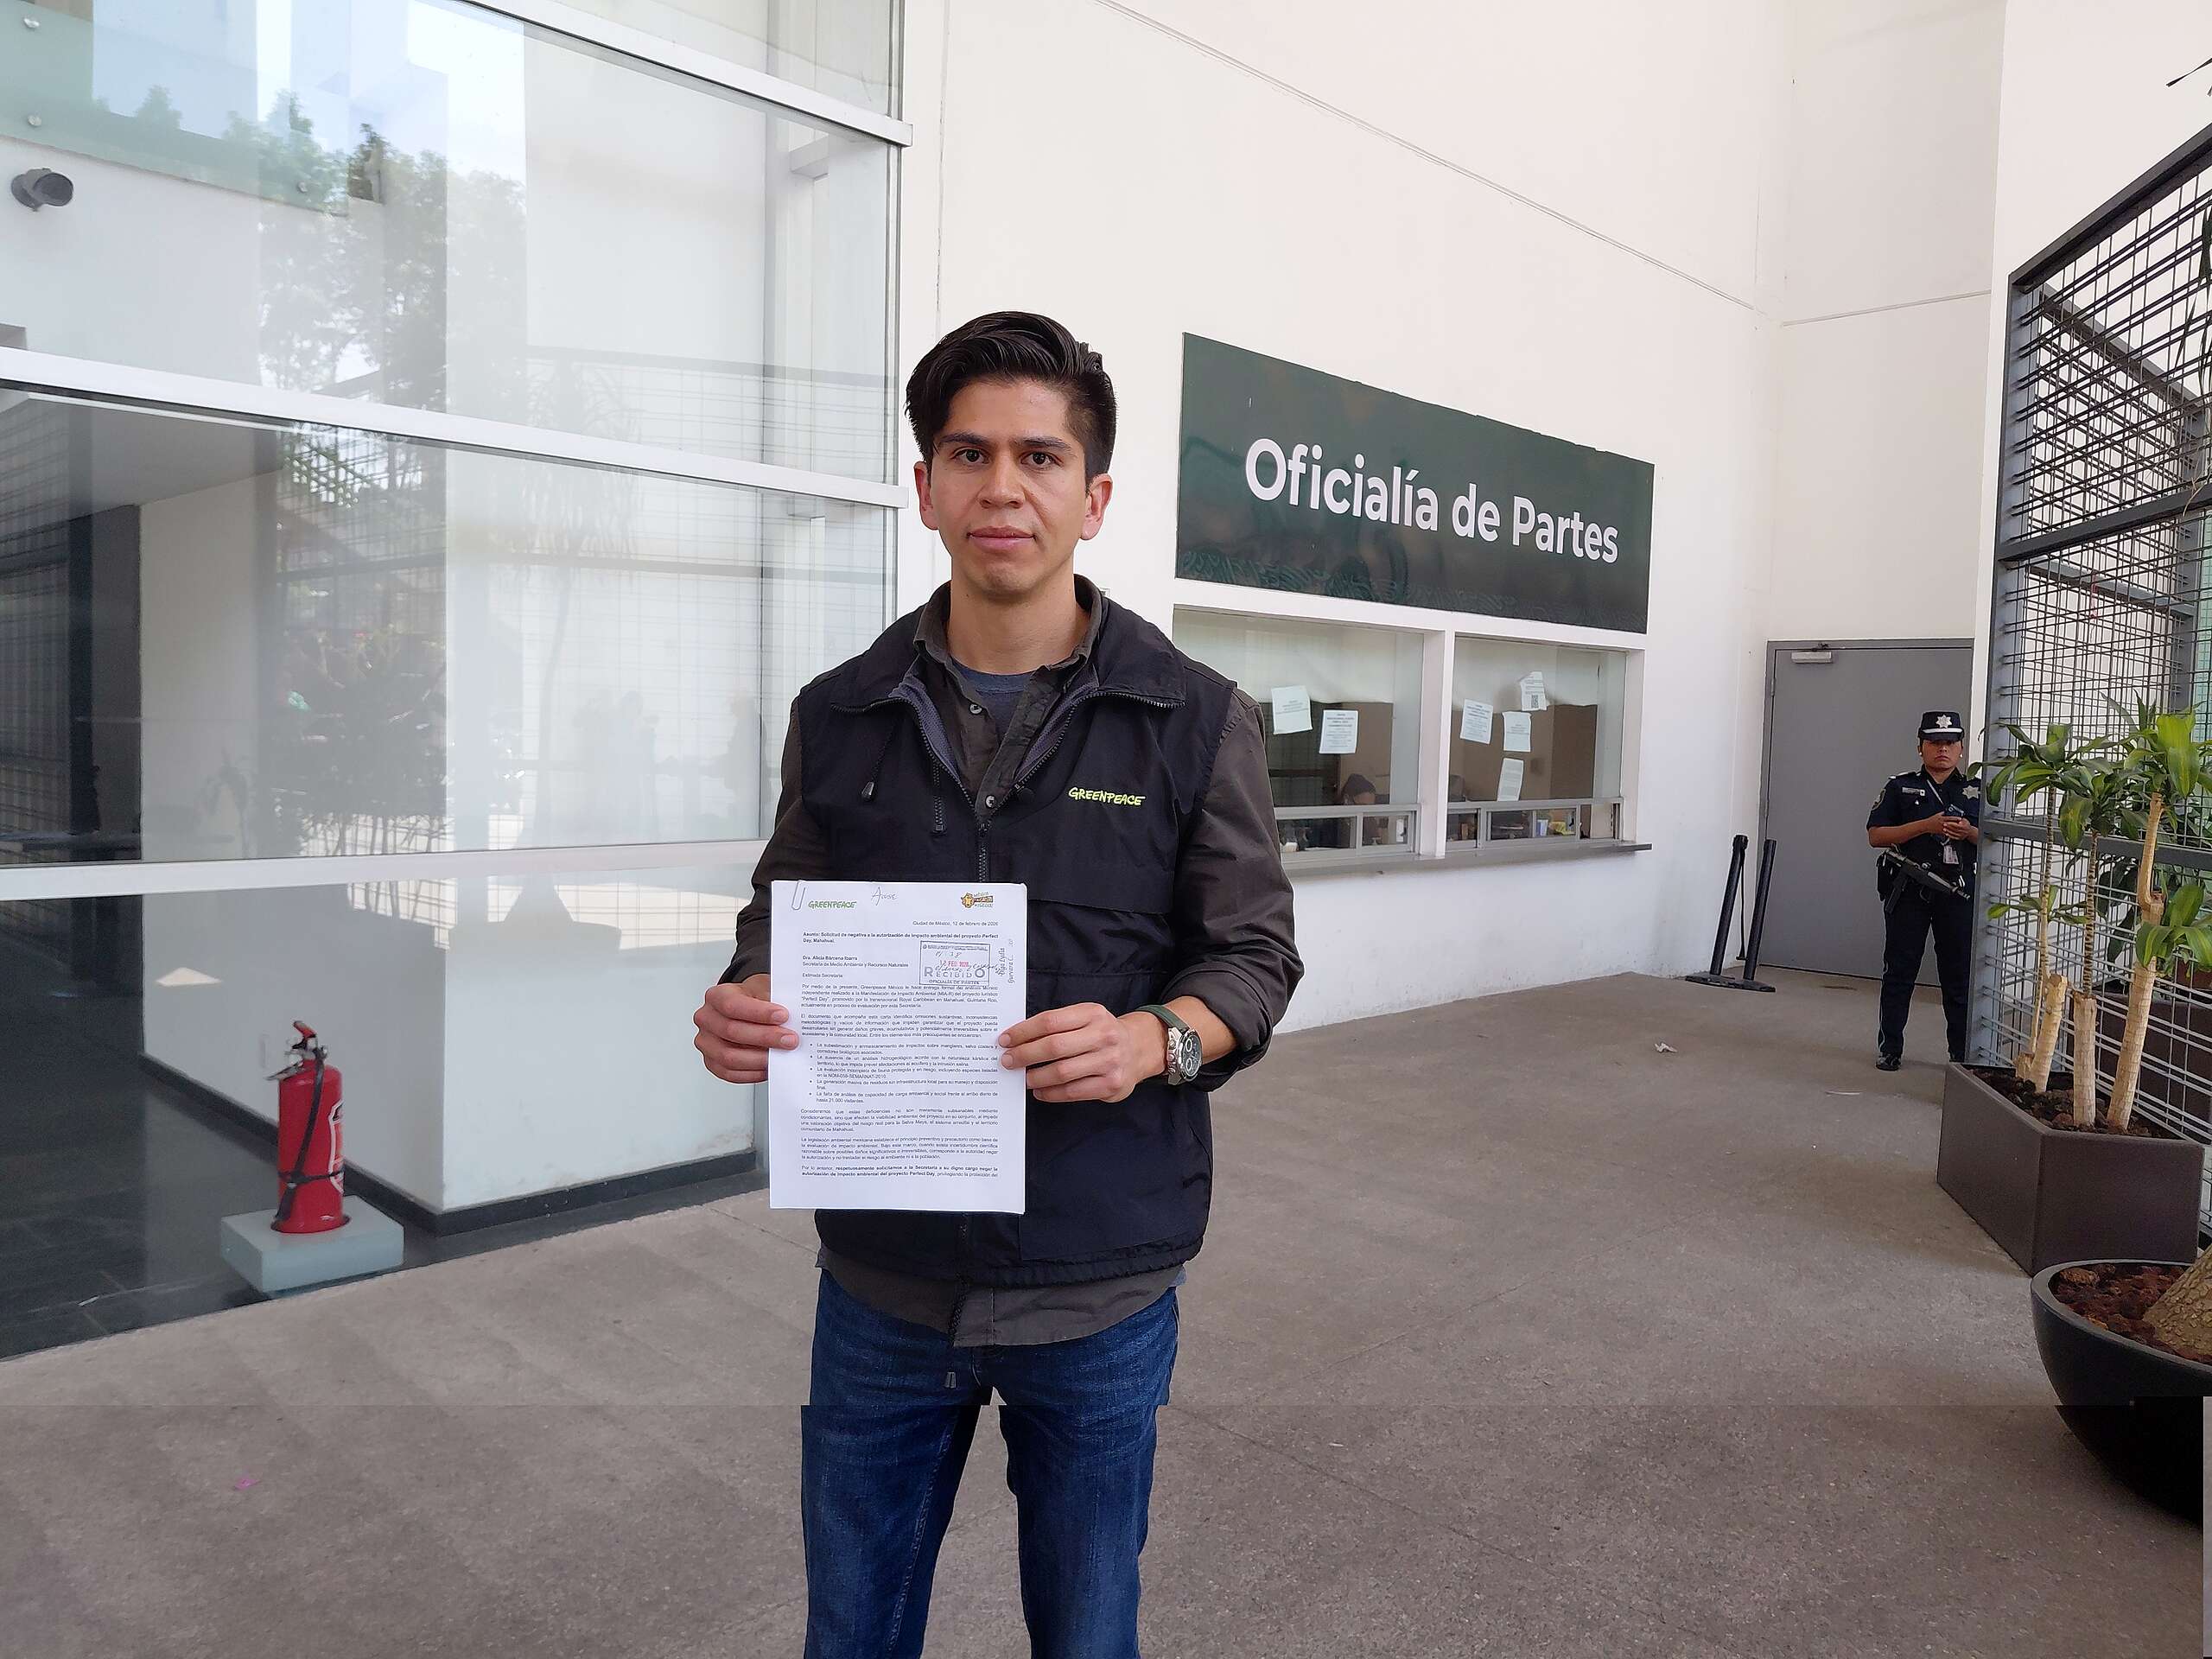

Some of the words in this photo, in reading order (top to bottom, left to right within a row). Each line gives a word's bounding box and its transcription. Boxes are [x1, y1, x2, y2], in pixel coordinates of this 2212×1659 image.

[1245, 438, 1438, 531] Oficialía
[1452, 483, 1500, 542] de
[1512, 496, 1619, 563] Partes
[1068, 787, 1146, 805] GREENPEACE
[808, 900, 857, 909] GREENPEACE
[924, 967, 985, 978] RECIBIDO
